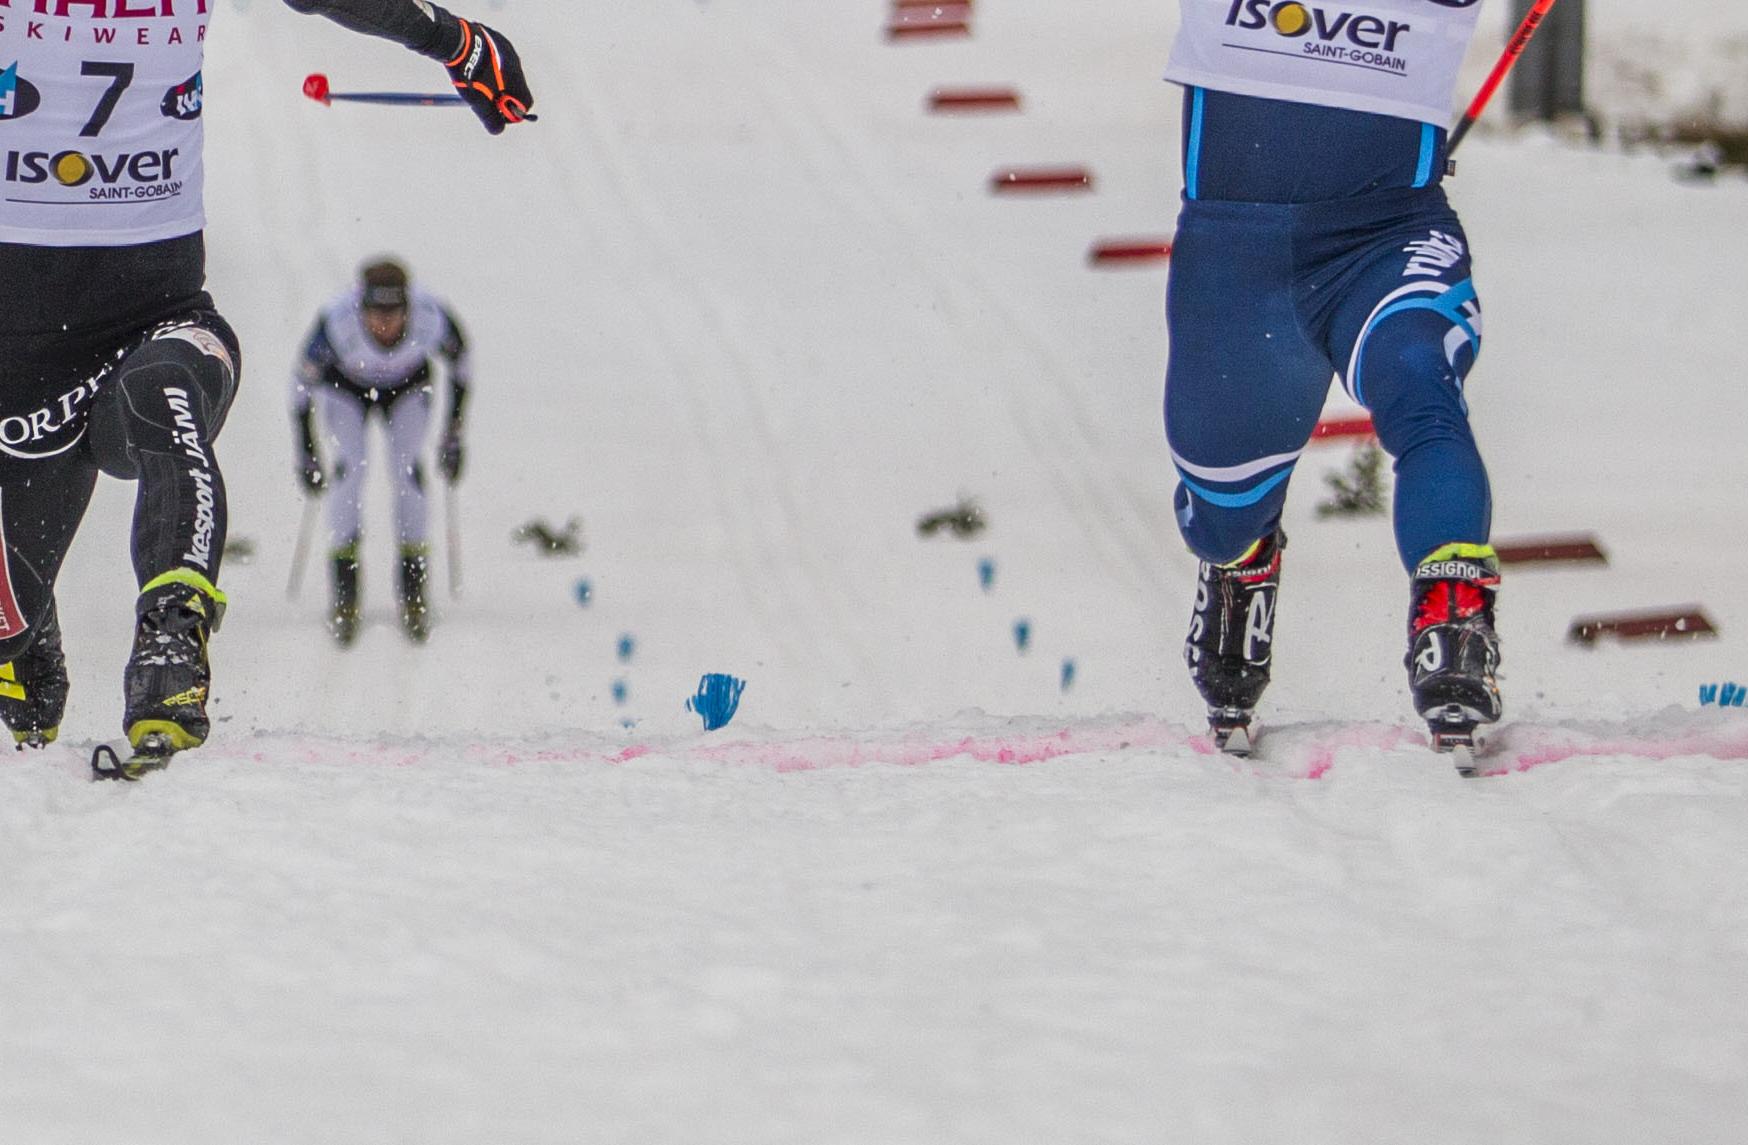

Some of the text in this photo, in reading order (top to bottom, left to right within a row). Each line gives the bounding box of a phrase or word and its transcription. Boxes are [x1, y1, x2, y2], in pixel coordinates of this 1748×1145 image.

[1302, 41, 1406, 71] SAINT-GOBAIN
[78, 60, 135, 137] 7
[89, 180, 183, 200] SAINT-GOBAIN
